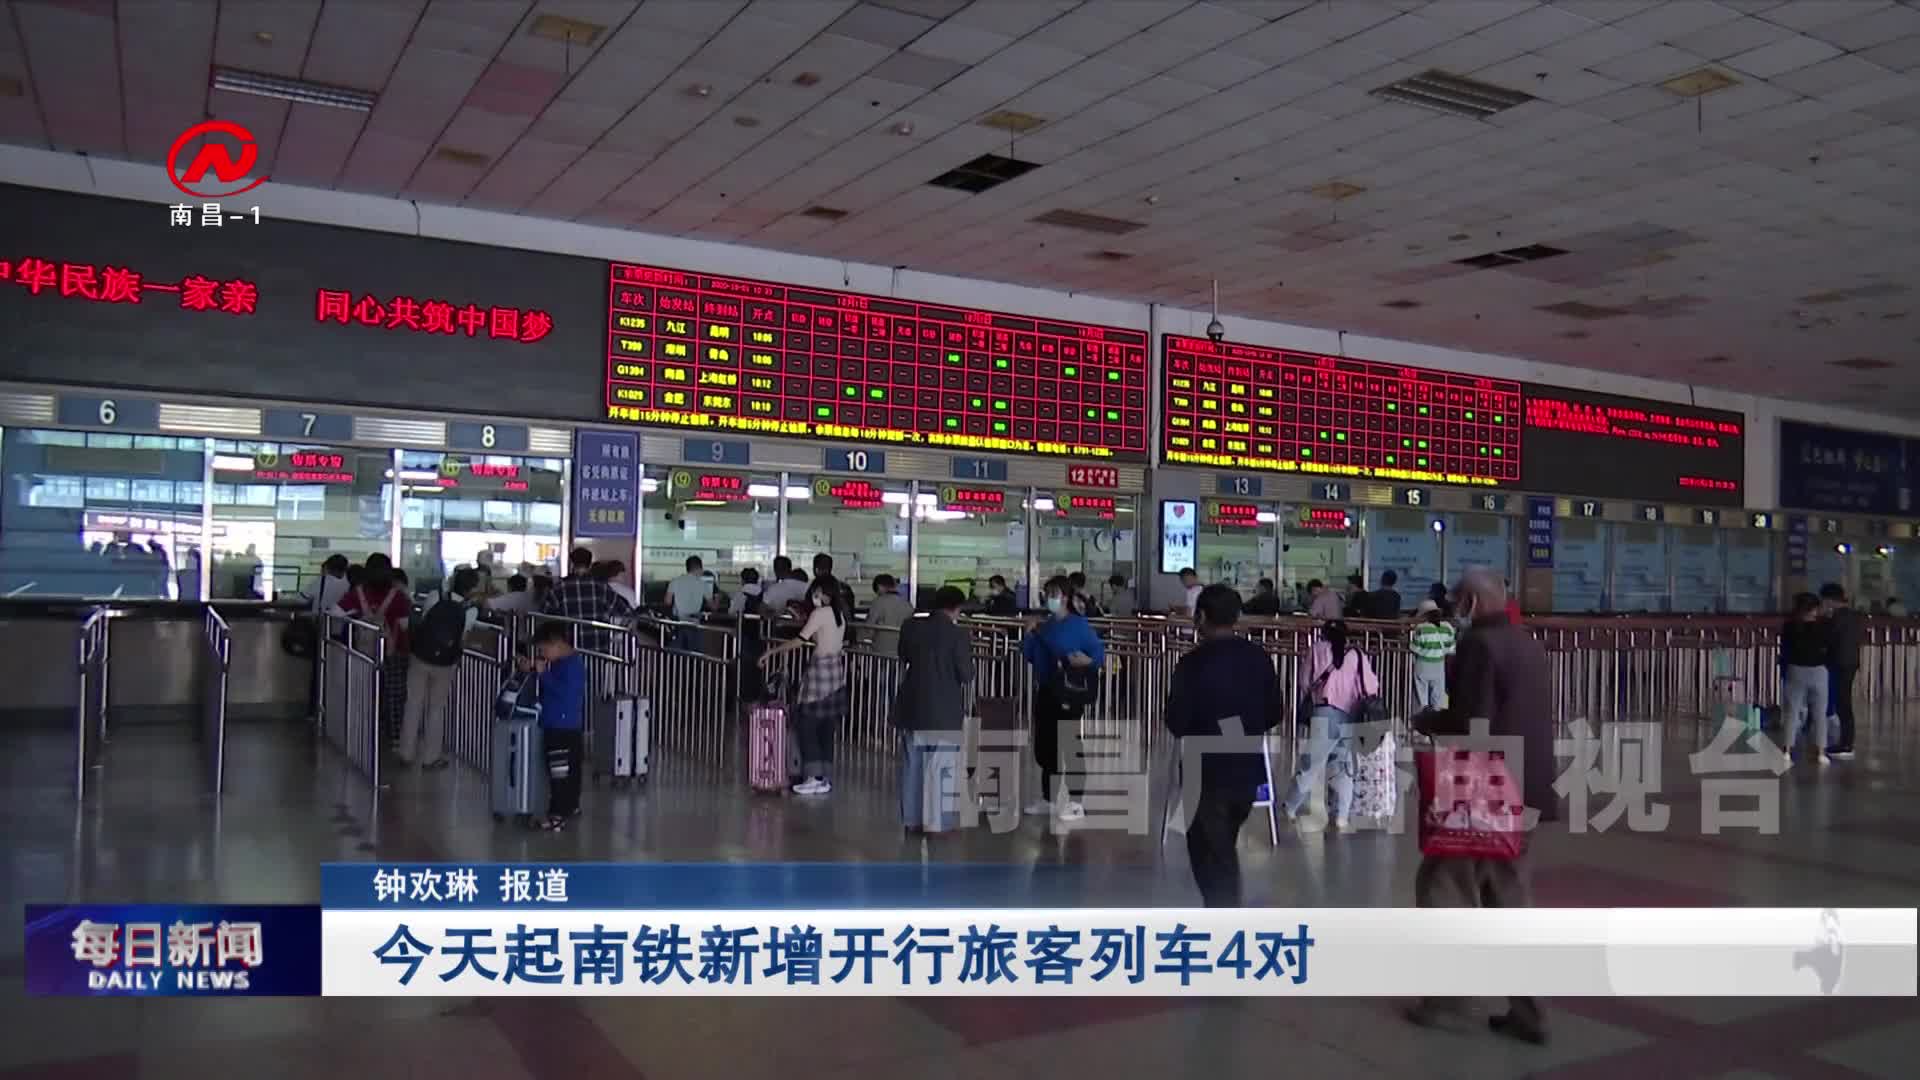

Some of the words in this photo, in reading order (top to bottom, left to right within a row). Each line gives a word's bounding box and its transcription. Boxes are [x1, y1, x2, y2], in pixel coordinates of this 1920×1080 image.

[620, 292, 645, 306] 车次
[659, 296, 695, 312] 始发站
[318, 289, 552, 341] 同心共筑中国梦
[667, 320, 687, 334] 九江
[99, 400, 116, 425] 6
[302, 414, 317, 436] 7
[482, 425, 496, 448] 8
[711, 441, 724, 462] 9
[846, 451, 868, 471] 10
[973, 460, 990, 479] 11
[1071, 469, 1085, 483] 12
[1233, 477, 1249, 495] 13
[1324, 483, 1340, 500] 14
[1406, 489, 1421, 505] 15
[1482, 496, 1496, 510] 16
[1583, 502, 1595, 517] 17
